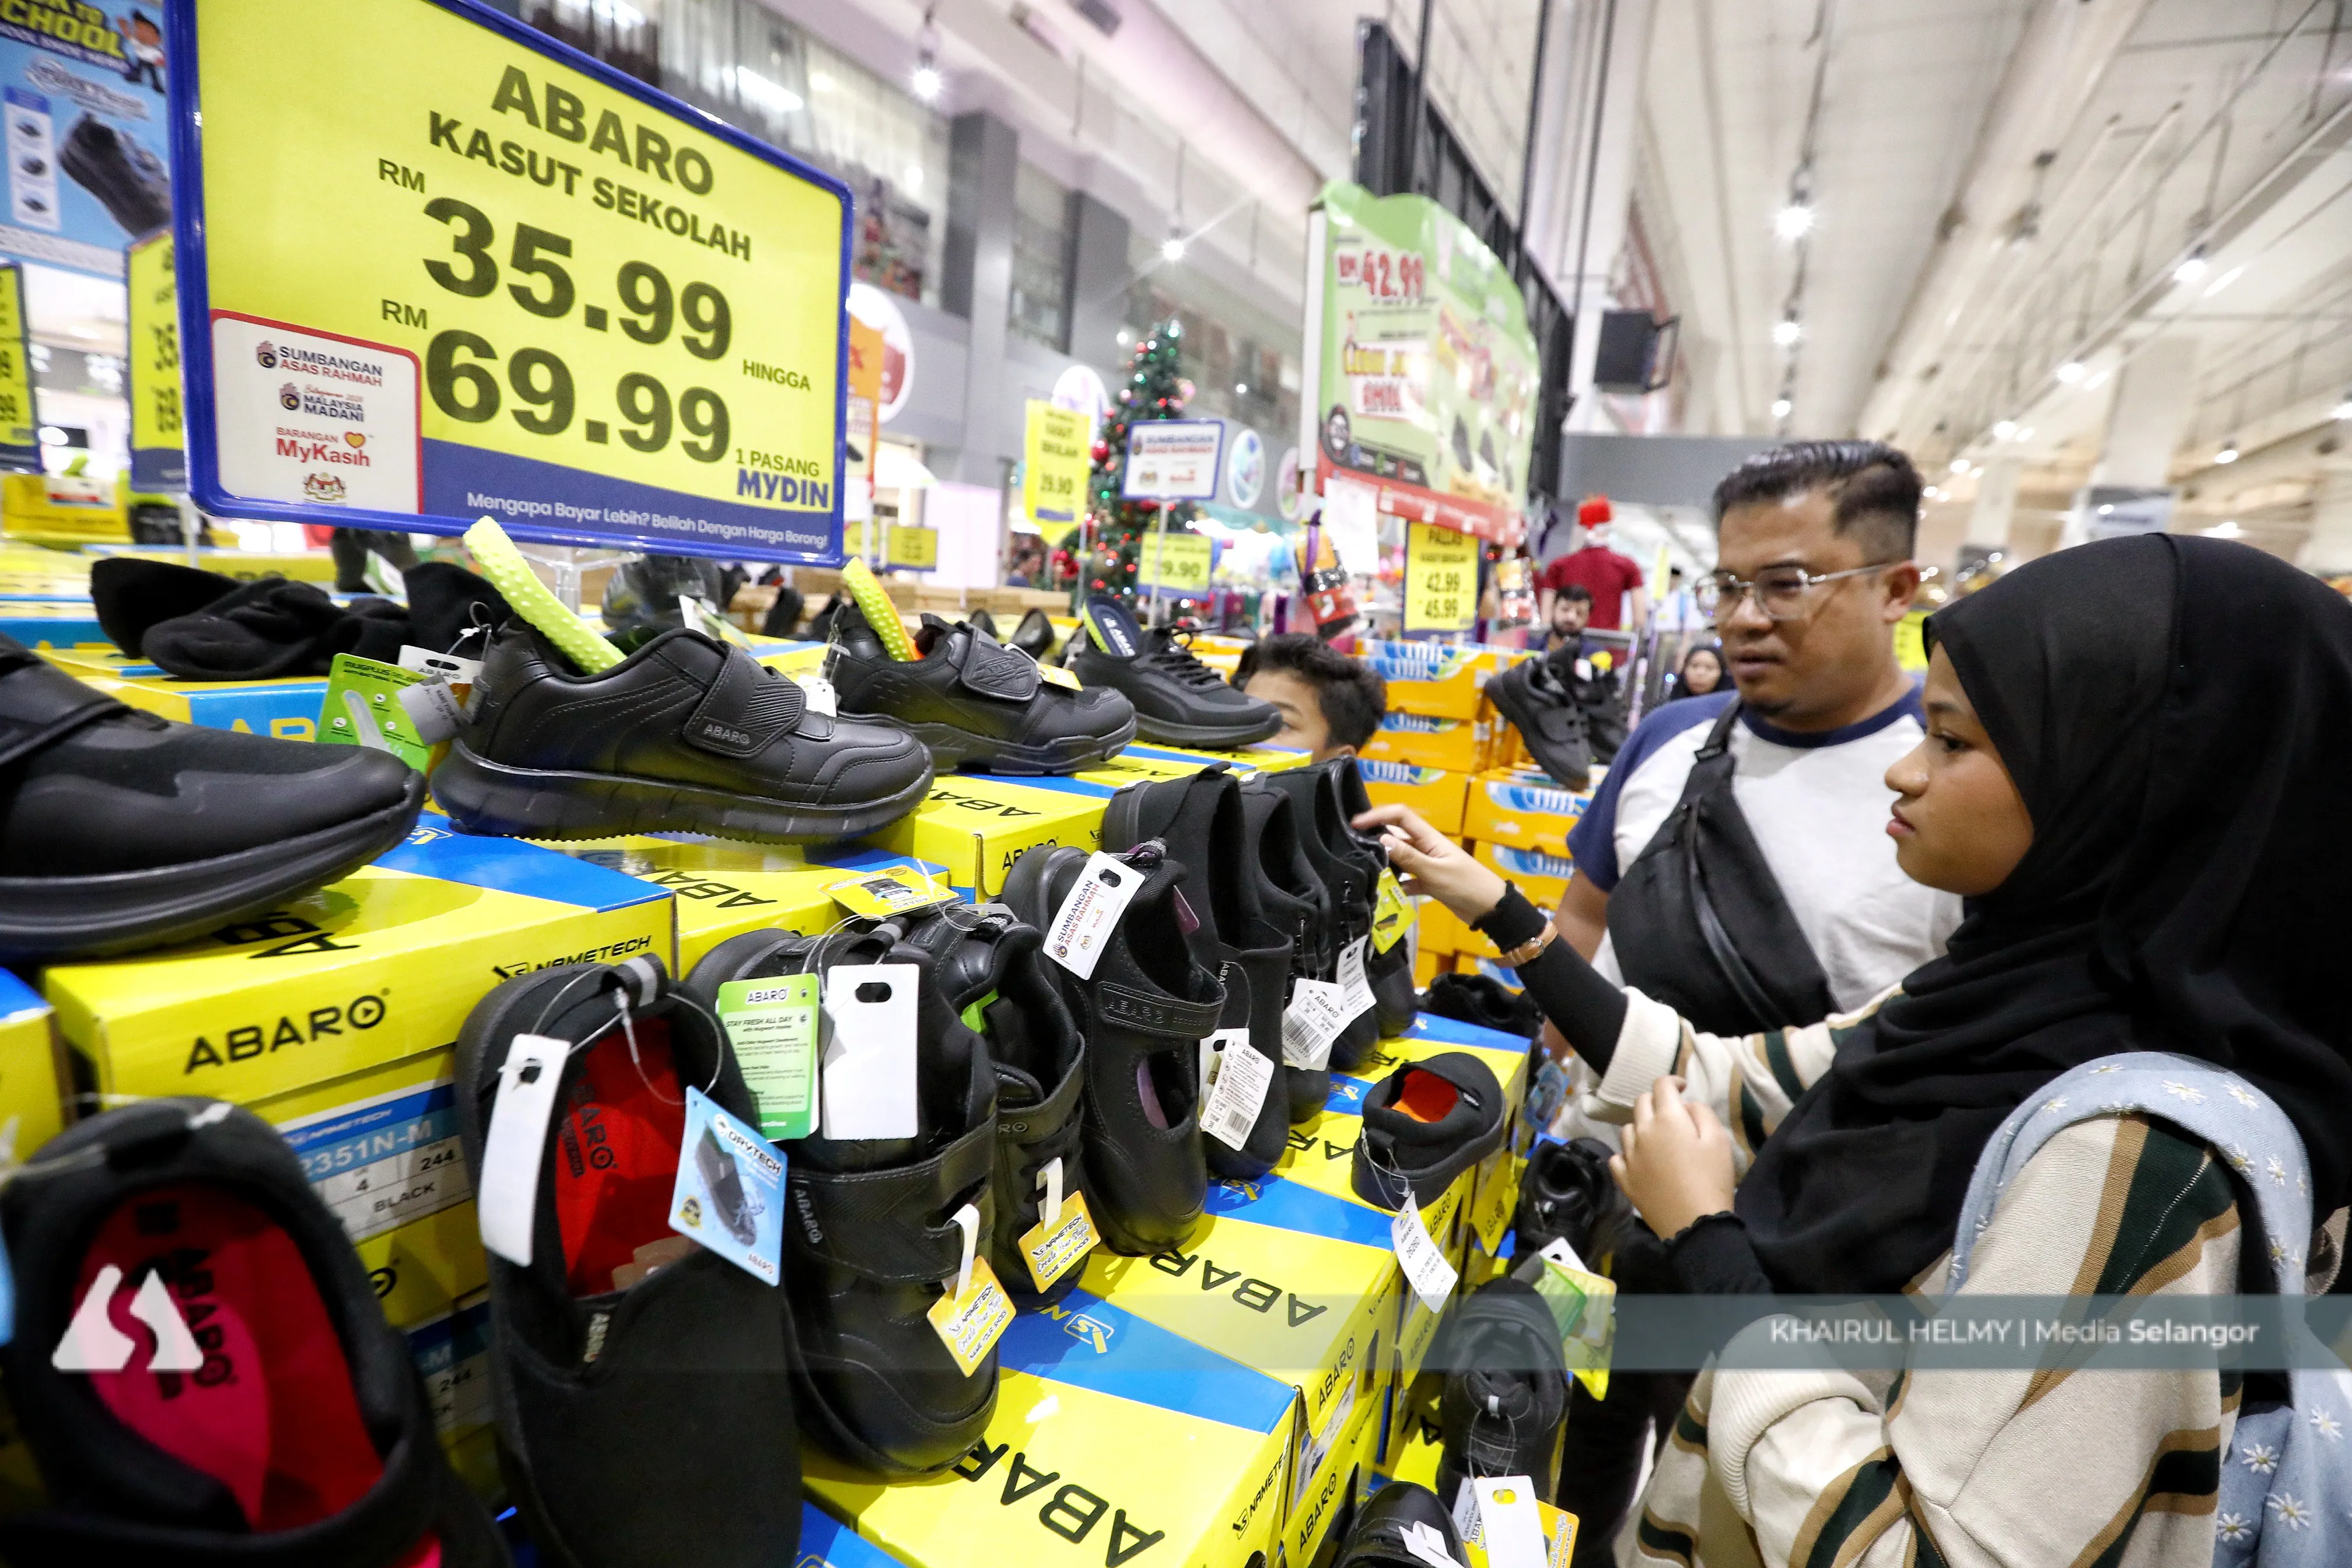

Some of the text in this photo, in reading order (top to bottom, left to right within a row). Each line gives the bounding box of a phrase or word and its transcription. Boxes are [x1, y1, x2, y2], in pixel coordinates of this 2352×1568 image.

[491, 65, 713, 195] ABARO
[429, 111, 751, 261] KASUT SEKOLAH
[379, 159, 732, 361] RM 35.99
[278, 346, 383, 376] SUMBANGAN
[279, 359, 383, 387] ASAS RAHMAH
[743, 360, 810, 391] HINGGA
[382, 299, 730, 463] RM 69.99
[304, 394, 363, 412] MALAYSIA
[304, 404, 365, 422] MADANI
[276, 426, 338, 443] BARANGAN
[276, 438, 370, 467] MyKasih
[736, 448, 820, 477] 1 PASANG
[737, 468, 829, 508] MYDIN
[467, 492, 552, 517] Mengapa
[555, 502, 601, 523] Bayar
[603, 508, 650, 526] Lebih?
[698, 520, 747, 539] Dengan
[748, 526, 783, 544] Harga
[786, 531, 828, 549] Borong!
[418, 667, 461, 680] ABRO
[702, 724, 750, 746] ABARO
[929, 789, 1042, 817] ABA
[652, 867, 778, 908] ABA
[1058, 880, 1094, 943] SUMBANGAN
[1065, 884, 1101, 946] ASAS RAHMAH
[1219, 963, 1230, 985] ABA
[747, 988, 788, 1003] ABARO
[1314, 995, 1340, 1019] ABARO
[185, 993, 387, 1074] ABARO
[420, 1149, 454, 1171] 244
[355, 1178, 370, 1192] 4
[373, 1181, 436, 1213] BLACK
[794, 1189, 824, 1244] ABARO
[1045, 1214, 1083, 1250] NAMETECH
[1044, 1264, 1059, 1279] NAME
[1060, 1251, 1073, 1265] YOUR
[962, 1283, 995, 1322] NAMETECH
[1319, 1337, 1356, 1411] ABARO
[1299, 1471, 1337, 1555] ABARO
